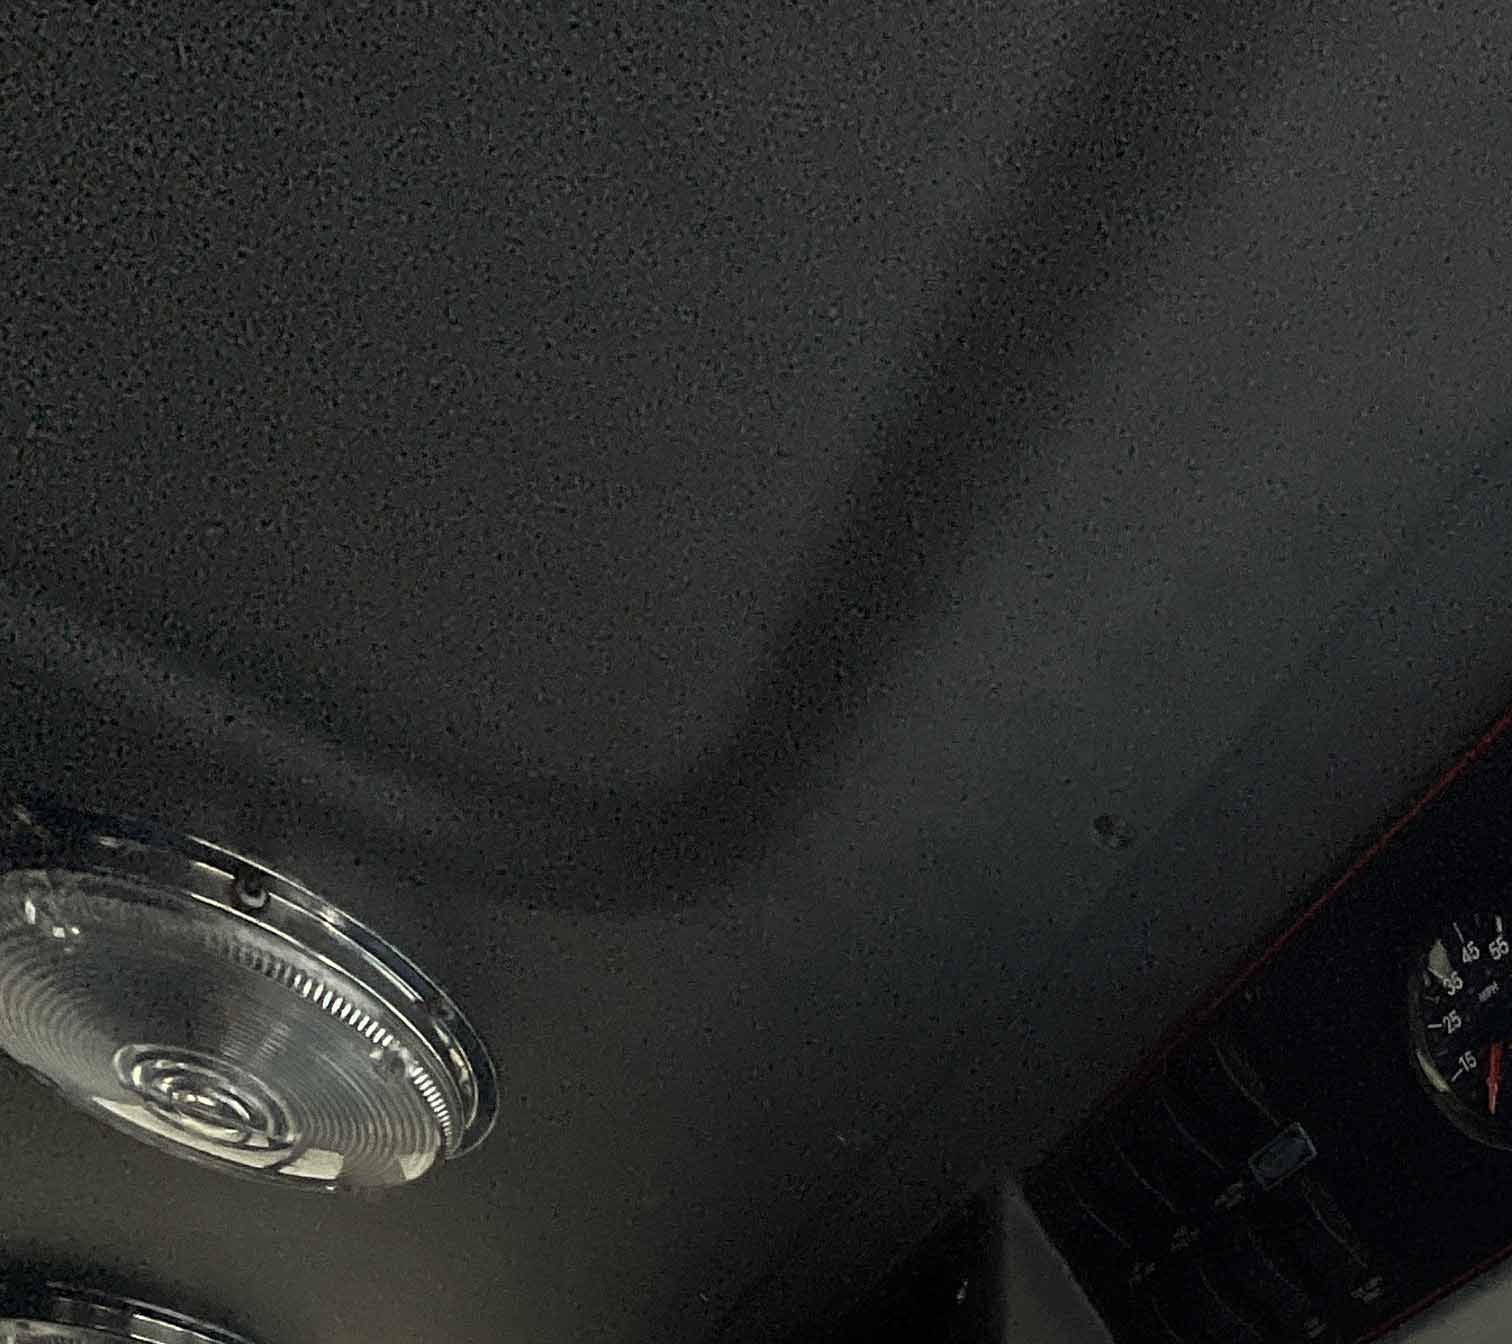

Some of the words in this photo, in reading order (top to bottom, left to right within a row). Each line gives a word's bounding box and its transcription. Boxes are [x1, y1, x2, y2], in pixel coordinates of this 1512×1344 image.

[1461, 940, 1480, 964] 45
[1488, 935, 1510, 960] 55
[1443, 971, 1464, 996] 35
[1443, 1009, 1462, 1034] 25
[1459, 1051, 1477, 1073] 15
